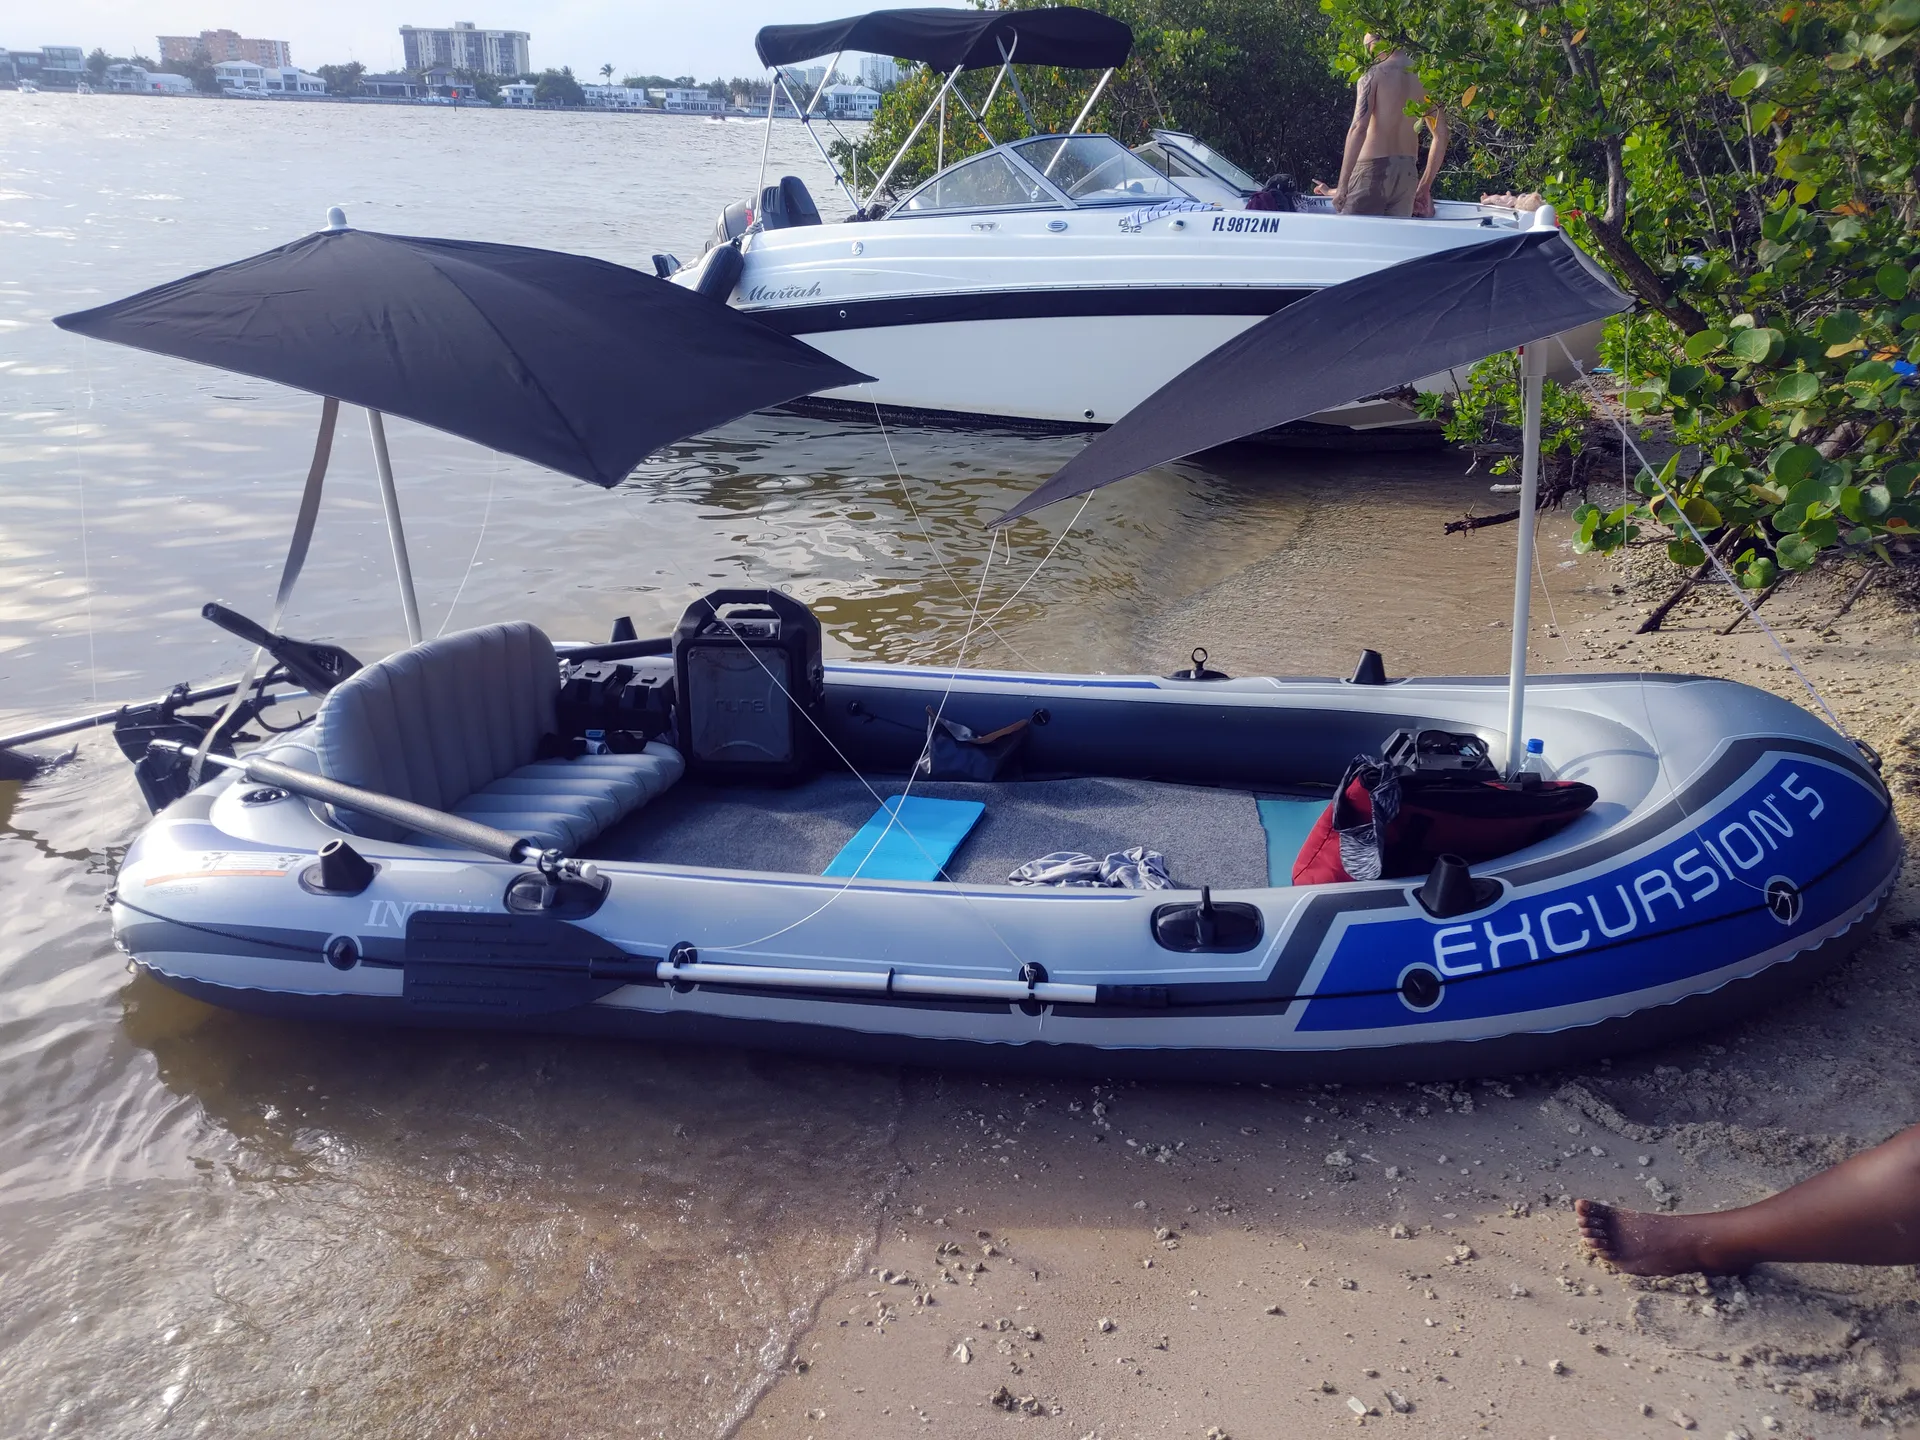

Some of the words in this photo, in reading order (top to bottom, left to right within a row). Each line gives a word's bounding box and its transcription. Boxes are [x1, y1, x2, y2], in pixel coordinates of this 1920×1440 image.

[1120, 225, 1142, 234] 212
[736, 281, 822, 303] Mariah
[1780, 772, 1824, 820] 5
